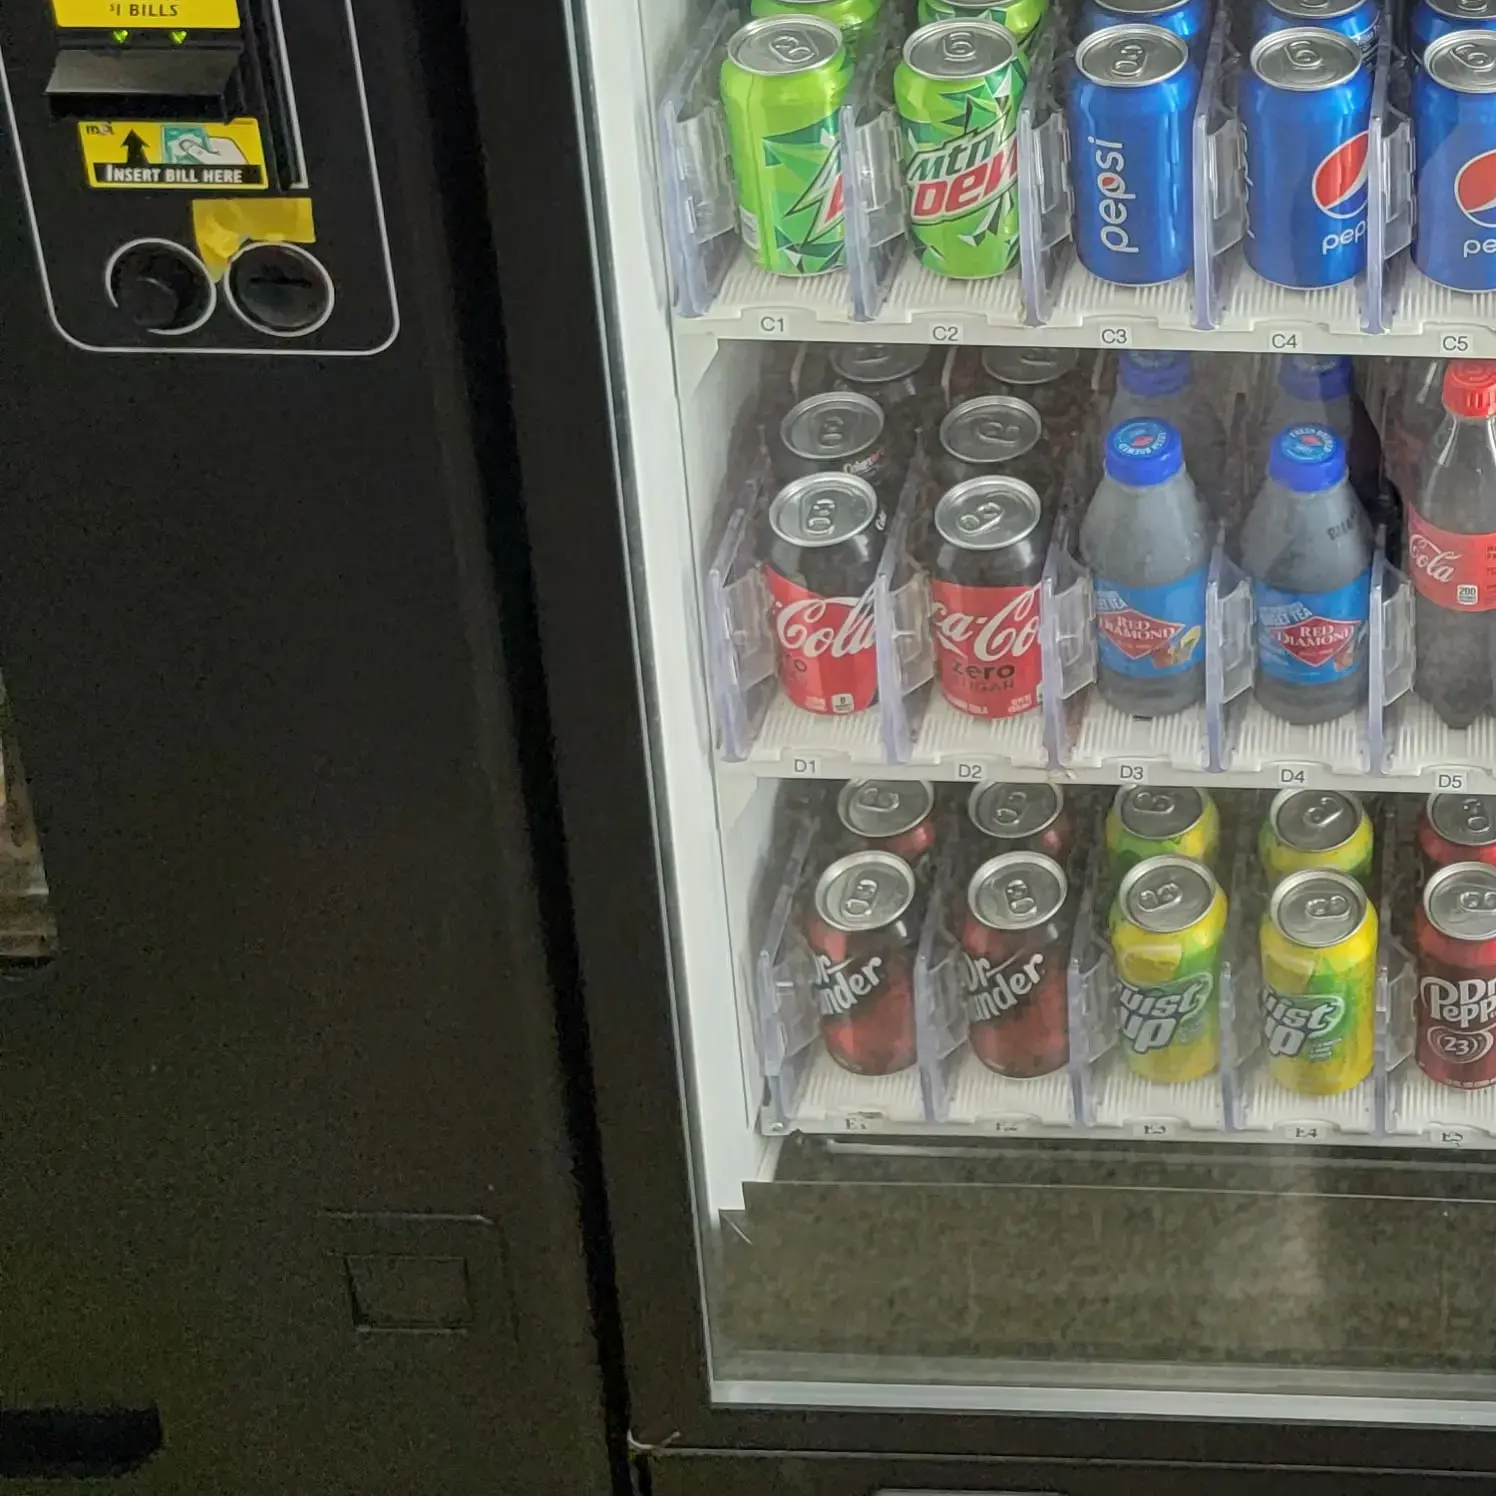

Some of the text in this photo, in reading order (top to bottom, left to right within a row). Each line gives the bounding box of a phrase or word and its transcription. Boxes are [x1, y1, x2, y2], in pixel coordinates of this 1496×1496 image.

[130, 4, 179, 18] BILLS
[106, 164, 242, 184] INSERT BILL HERE
[1088, 136, 1139, 253] pepsi
[760, 316, 785, 332] C1
[932, 326, 959, 342] C2
[1101, 328, 1127, 344] C3
[1272, 333, 1298, 349] C4
[1442, 336, 1468, 351] C5
[1116, 616, 1150, 630] RED
[1300, 624, 1335, 637] RED
[794, 760, 816, 773] D1
[958, 764, 982, 779] D2
[1120, 765, 1144, 780] D3
[1281, 769, 1305, 784] D4
[1438, 775, 1462, 789] D5
[1444, 1036, 1470, 1055] 23
